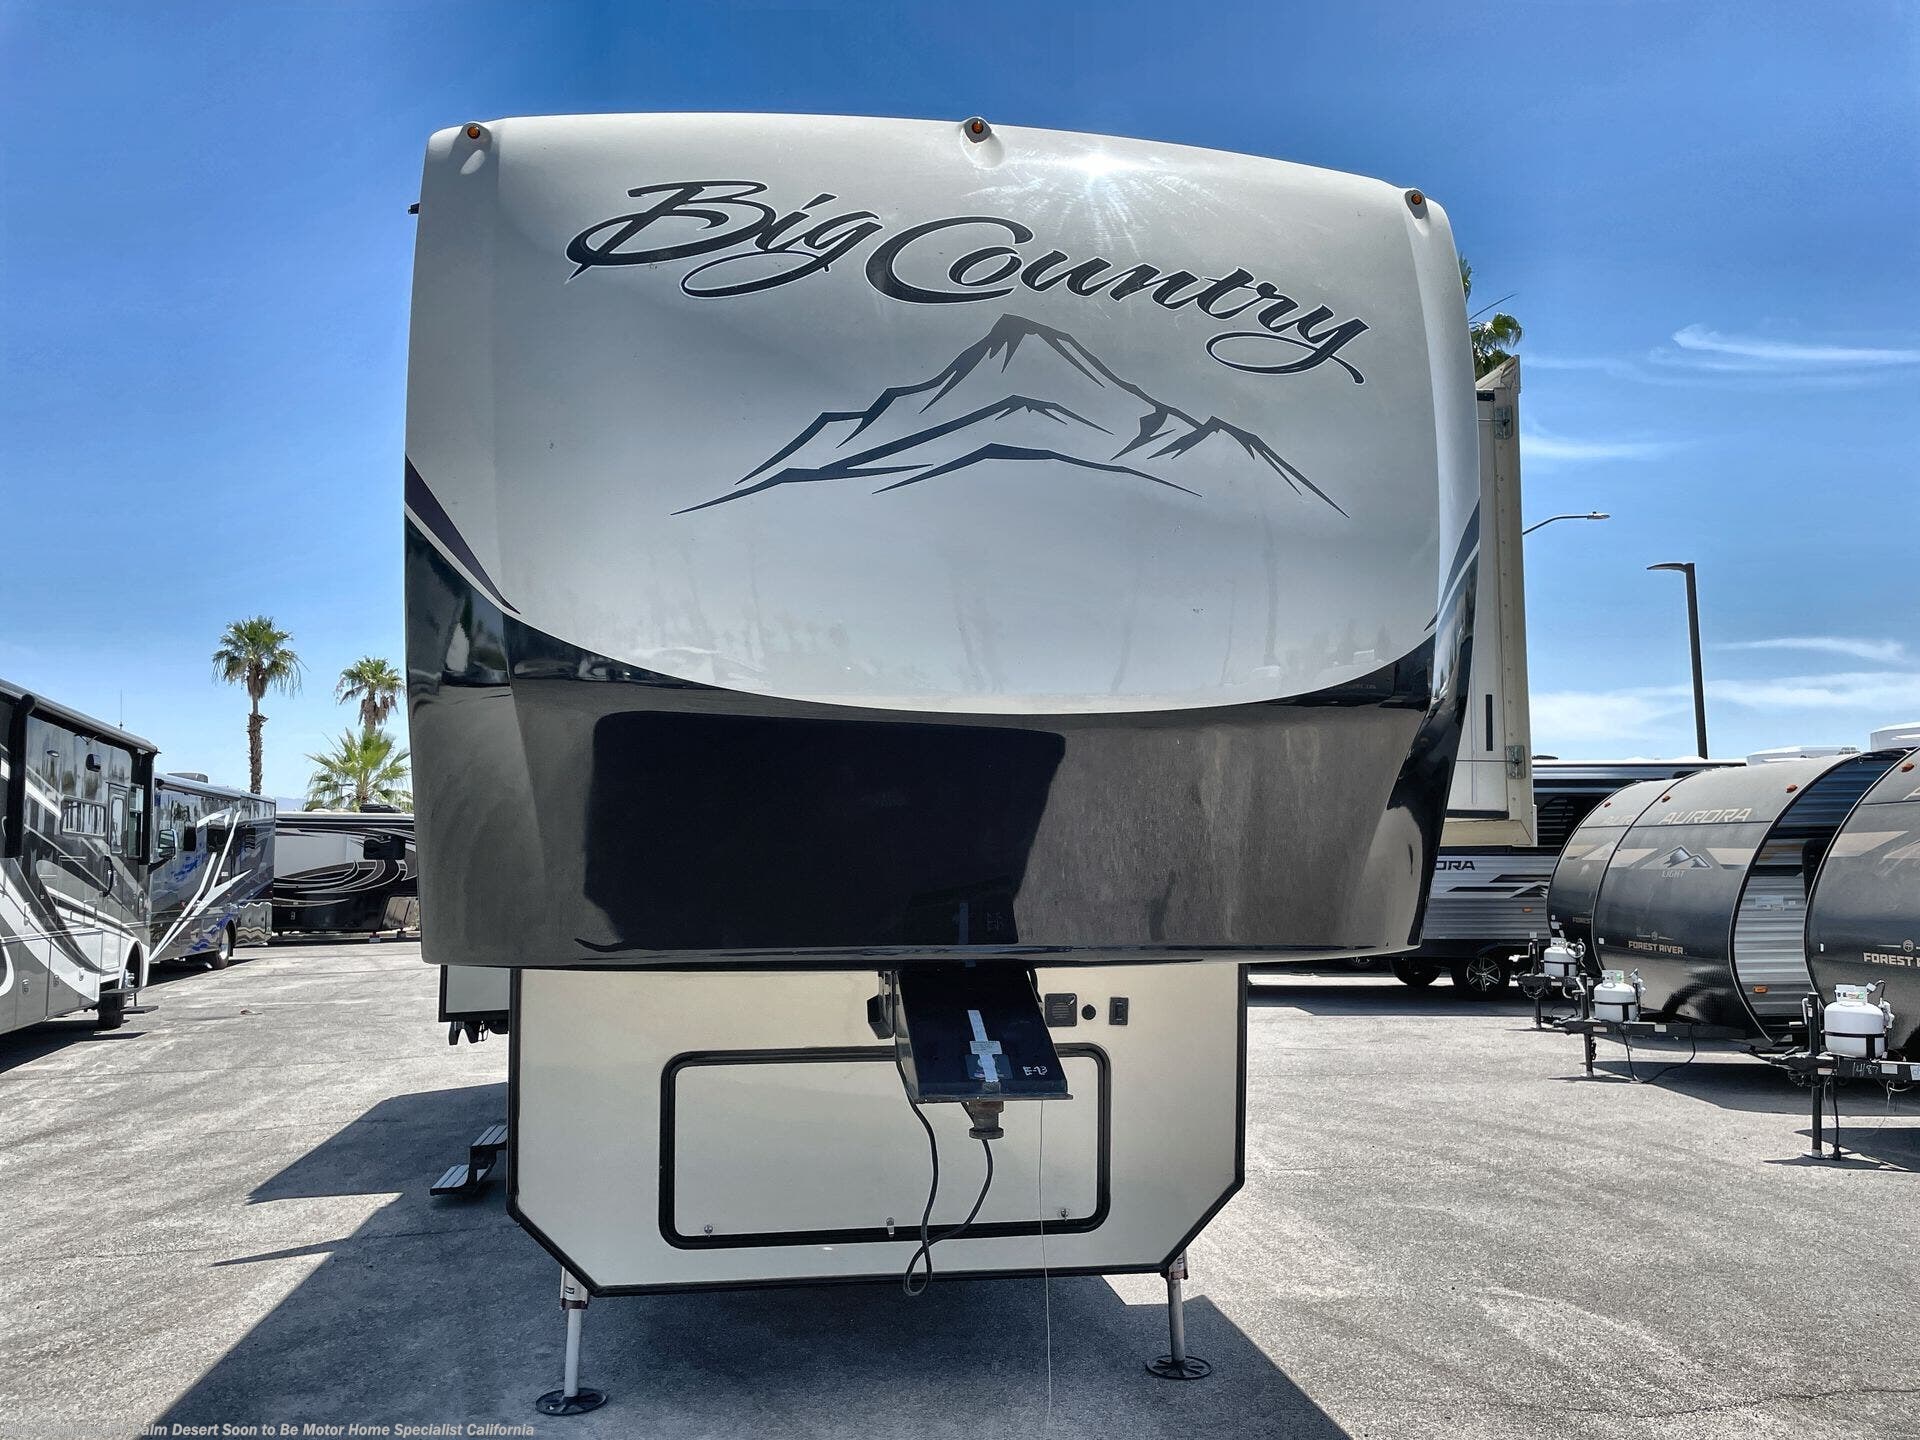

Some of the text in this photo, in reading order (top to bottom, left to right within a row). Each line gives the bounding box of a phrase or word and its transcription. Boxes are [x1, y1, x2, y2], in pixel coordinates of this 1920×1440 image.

[565, 180, 1370, 385] Big Country
[1602, 815, 1635, 825] AUR
[1658, 808, 1752, 825] AURORA
[1435, 861, 1475, 870] ORA
[1628, 941, 1684, 955] FOREST RIVER
[1863, 952, 1914, 967] FOREST
